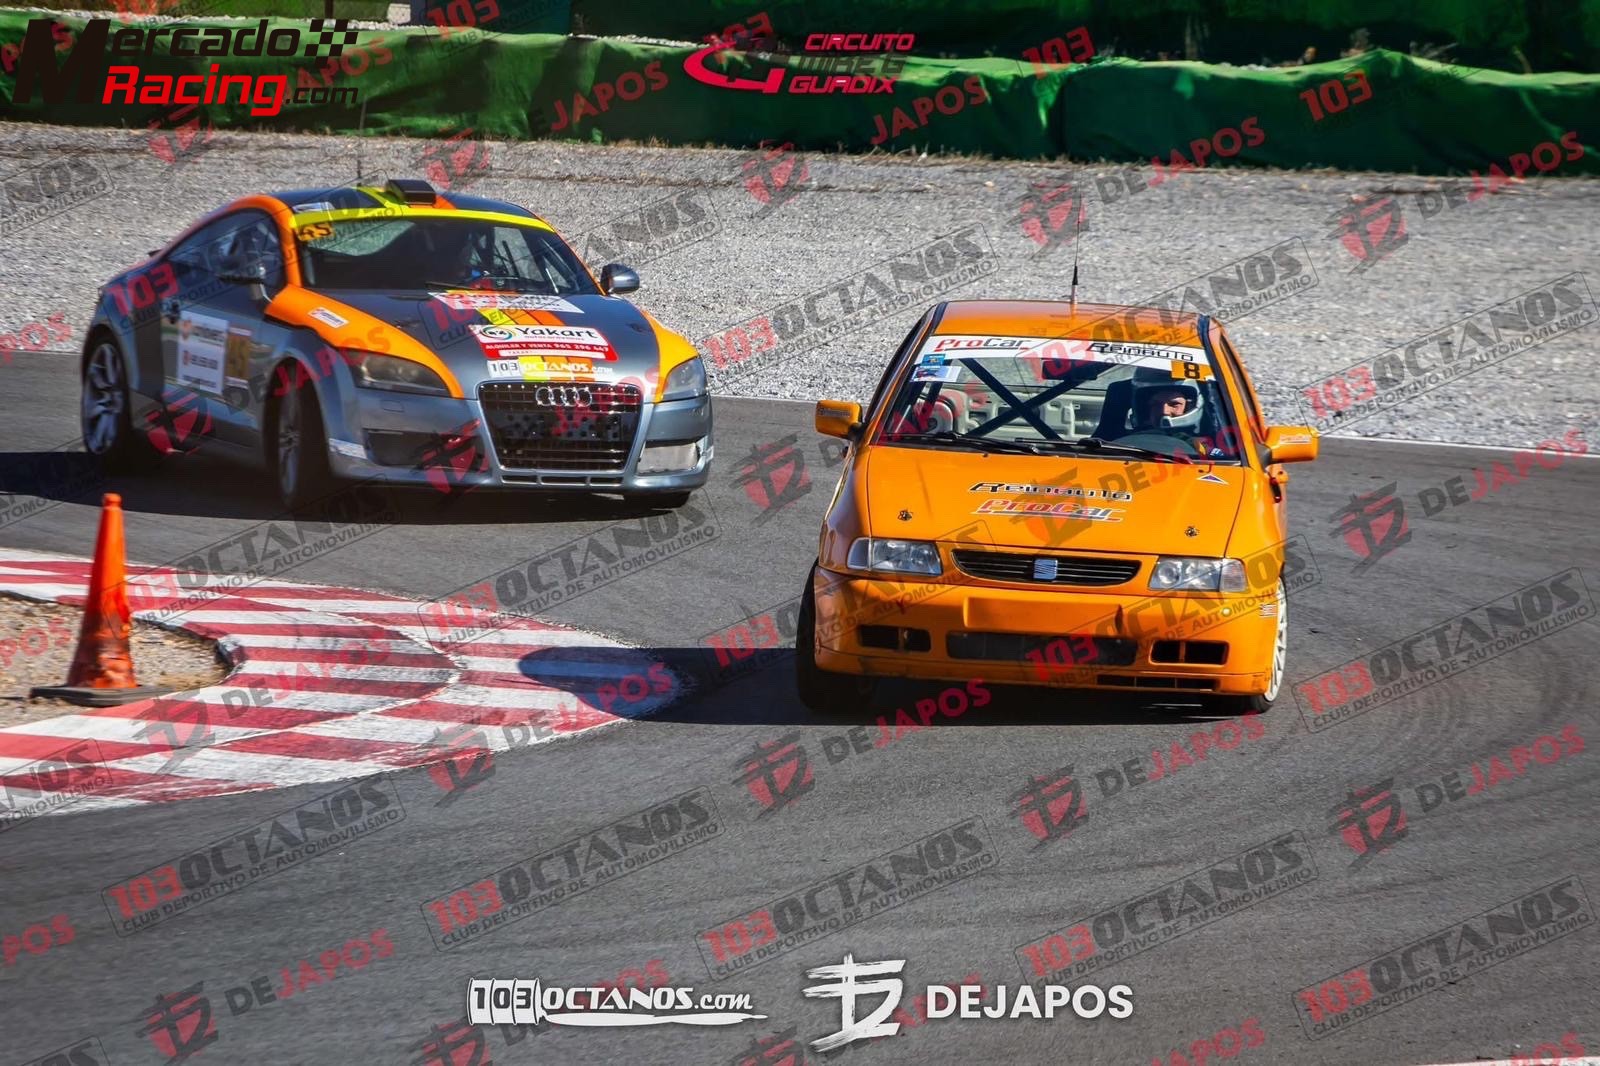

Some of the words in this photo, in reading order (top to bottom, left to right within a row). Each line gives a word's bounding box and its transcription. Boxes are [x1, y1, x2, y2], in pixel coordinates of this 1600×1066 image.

[515, 327, 598, 339] Yakart
[935, 338, 1032, 350] ProCar
[1184, 362, 1200, 379] 8
[975, 499, 1127, 519] ProCar
